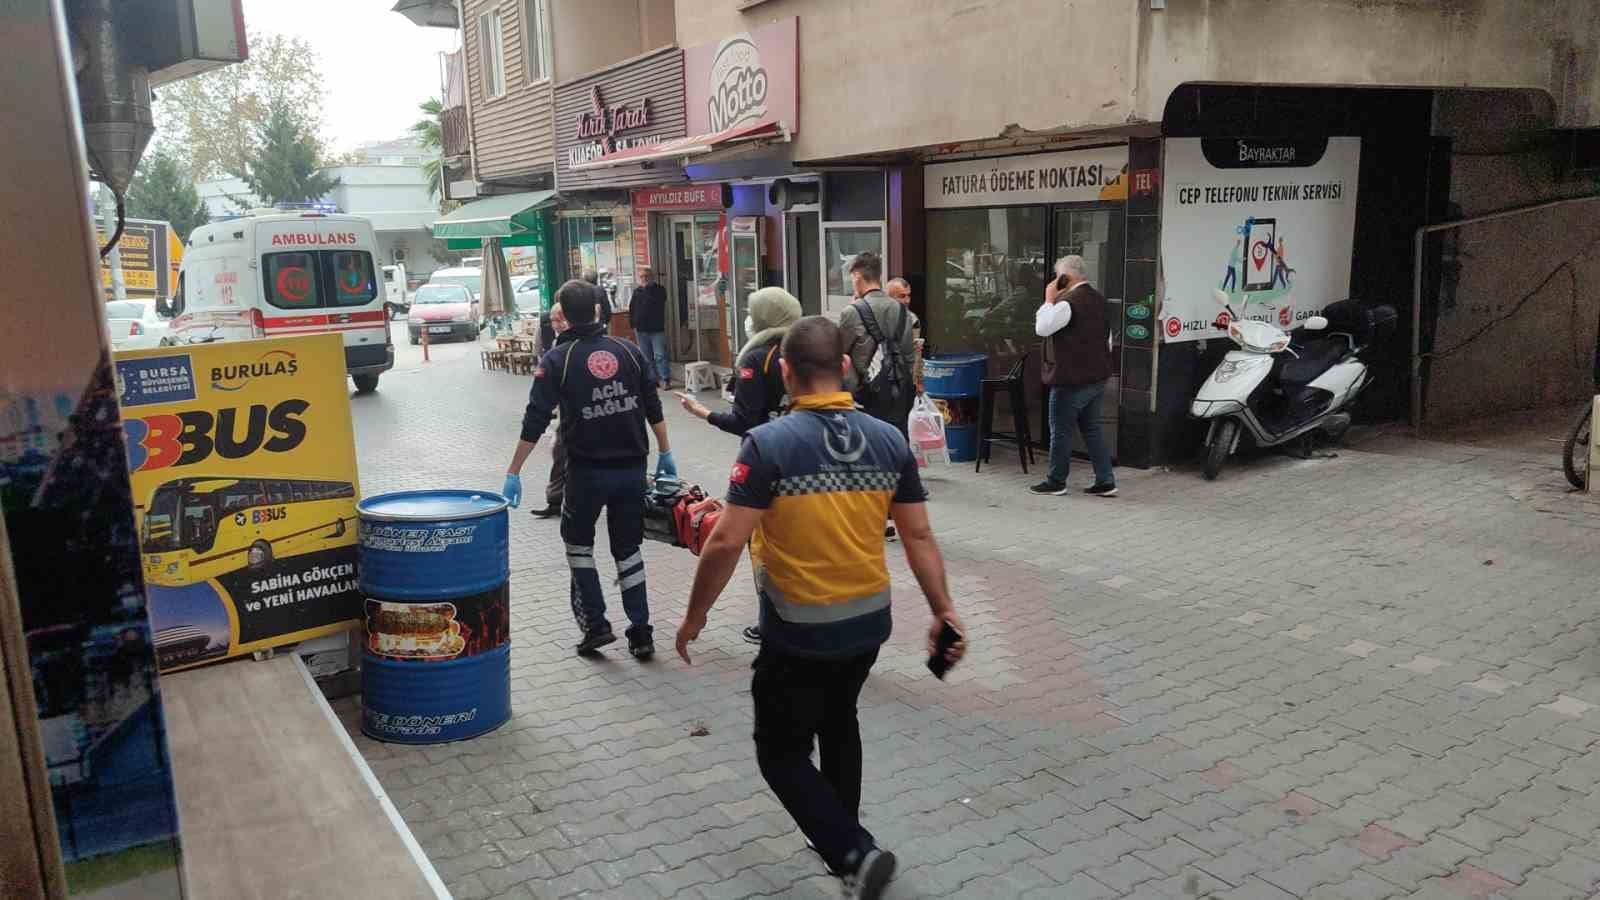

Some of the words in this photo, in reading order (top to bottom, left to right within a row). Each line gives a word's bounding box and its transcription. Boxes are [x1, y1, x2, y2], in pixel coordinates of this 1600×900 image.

[708, 66, 768, 132] Motto
[1239, 144, 1296, 162] BAYRAKTAR
[942, 171, 987, 195] FATURA
[990, 166, 1036, 192] ÖDEME
[1039, 164, 1103, 188] NOKTASI
[1179, 187, 1201, 204] CEP
[1205, 185, 1258, 203] TELEFONU
[1262, 182, 1299, 201] TEKNİK
[1302, 180, 1342, 200] SERVİSİ
[271, 233, 357, 246] AMBULANS
[1182, 320, 1207, 331] HIZLI
[139, 366, 188, 380] BURSA
[211, 359, 299, 382] BURULAŞ
[592, 381, 628, 401] ACİL
[581, 395, 639, 420] SAĞLIK
[251, 571, 301, 594] SABİHA
[303, 562, 353, 585] GÖKÇEN
[246, 601, 261, 612] ve
[263, 588, 294, 609] YENİ
